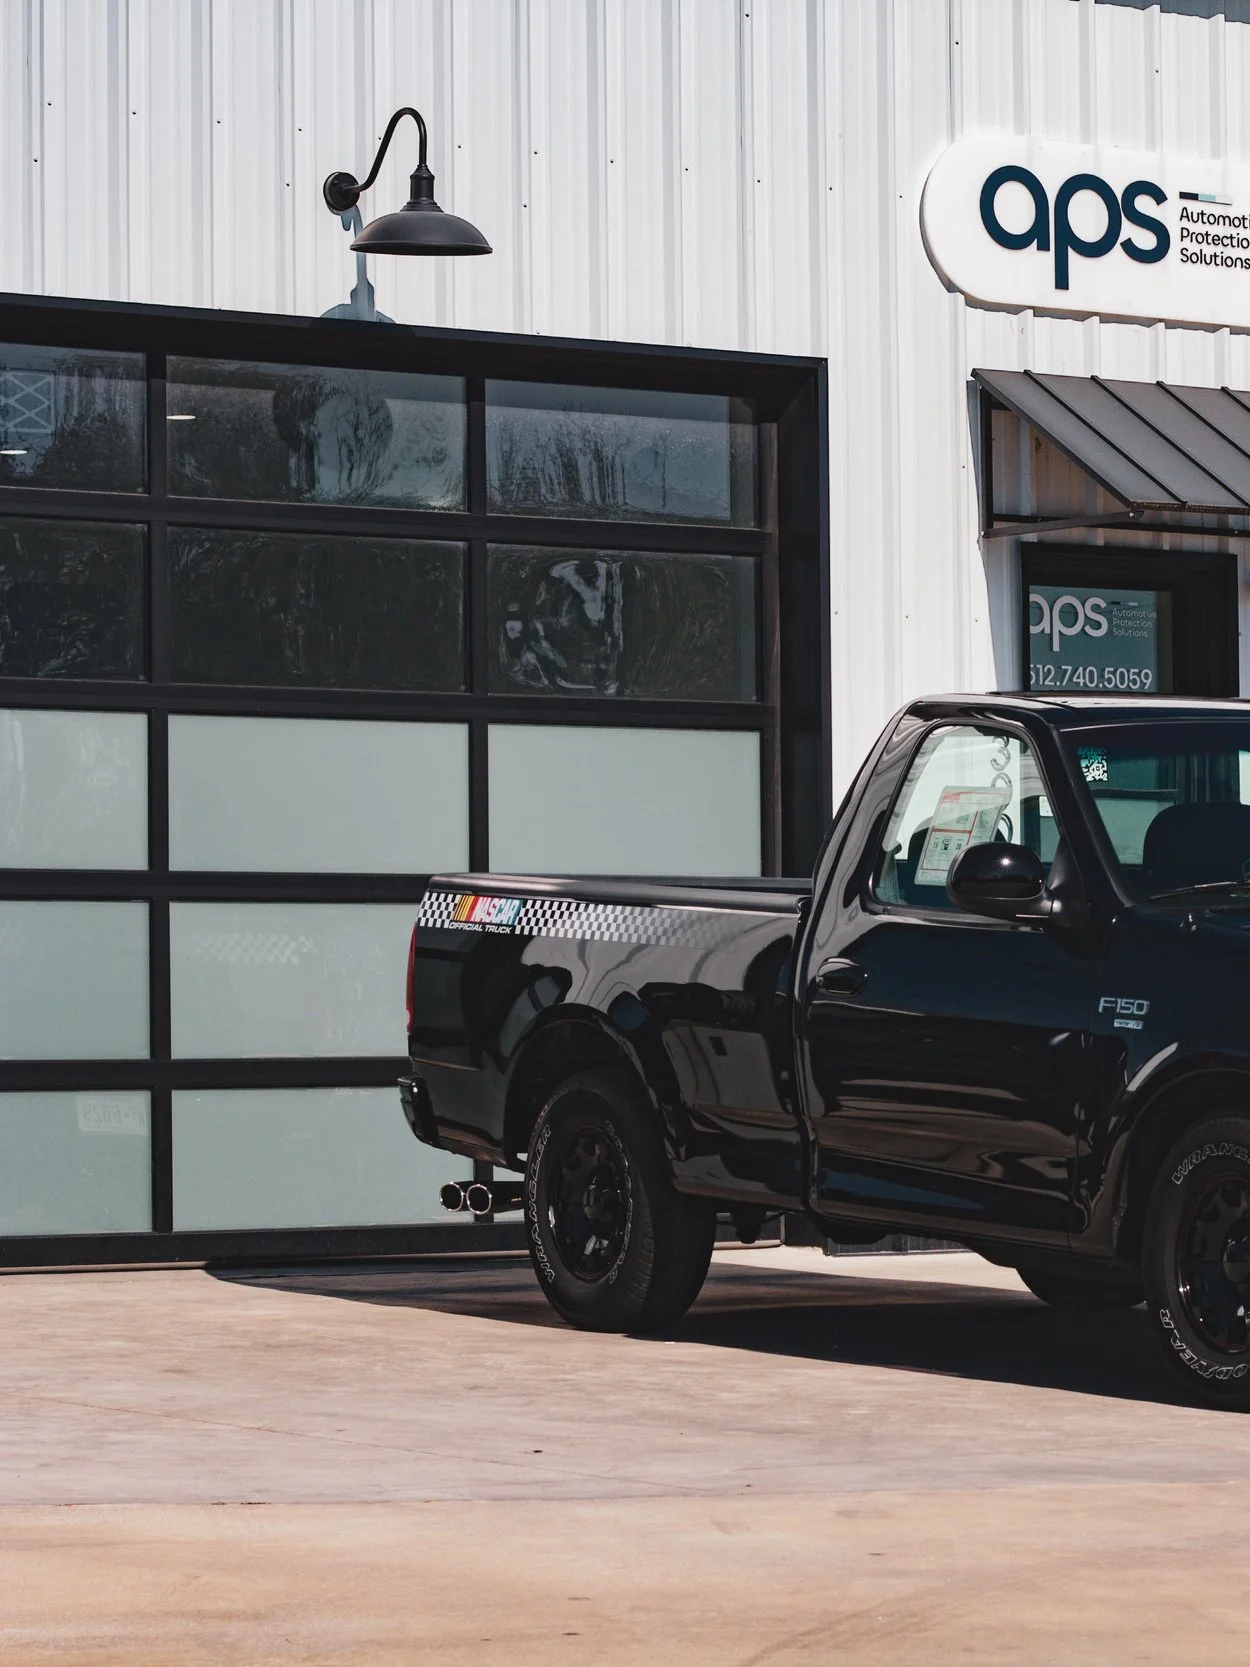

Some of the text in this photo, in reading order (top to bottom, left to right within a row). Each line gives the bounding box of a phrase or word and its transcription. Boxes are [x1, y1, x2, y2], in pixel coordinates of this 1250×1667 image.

[979, 164, 1171, 291] aps
[1112, 608, 1157, 619] Automotive
[1112, 617, 1153, 628] Protection
[1112, 627, 1149, 638] Solutions
[471, 897, 519, 924] NASCAR
[449, 921, 513, 935] OFFICIAL TRUCK
[528, 1123, 556, 1284] WRANGLER
